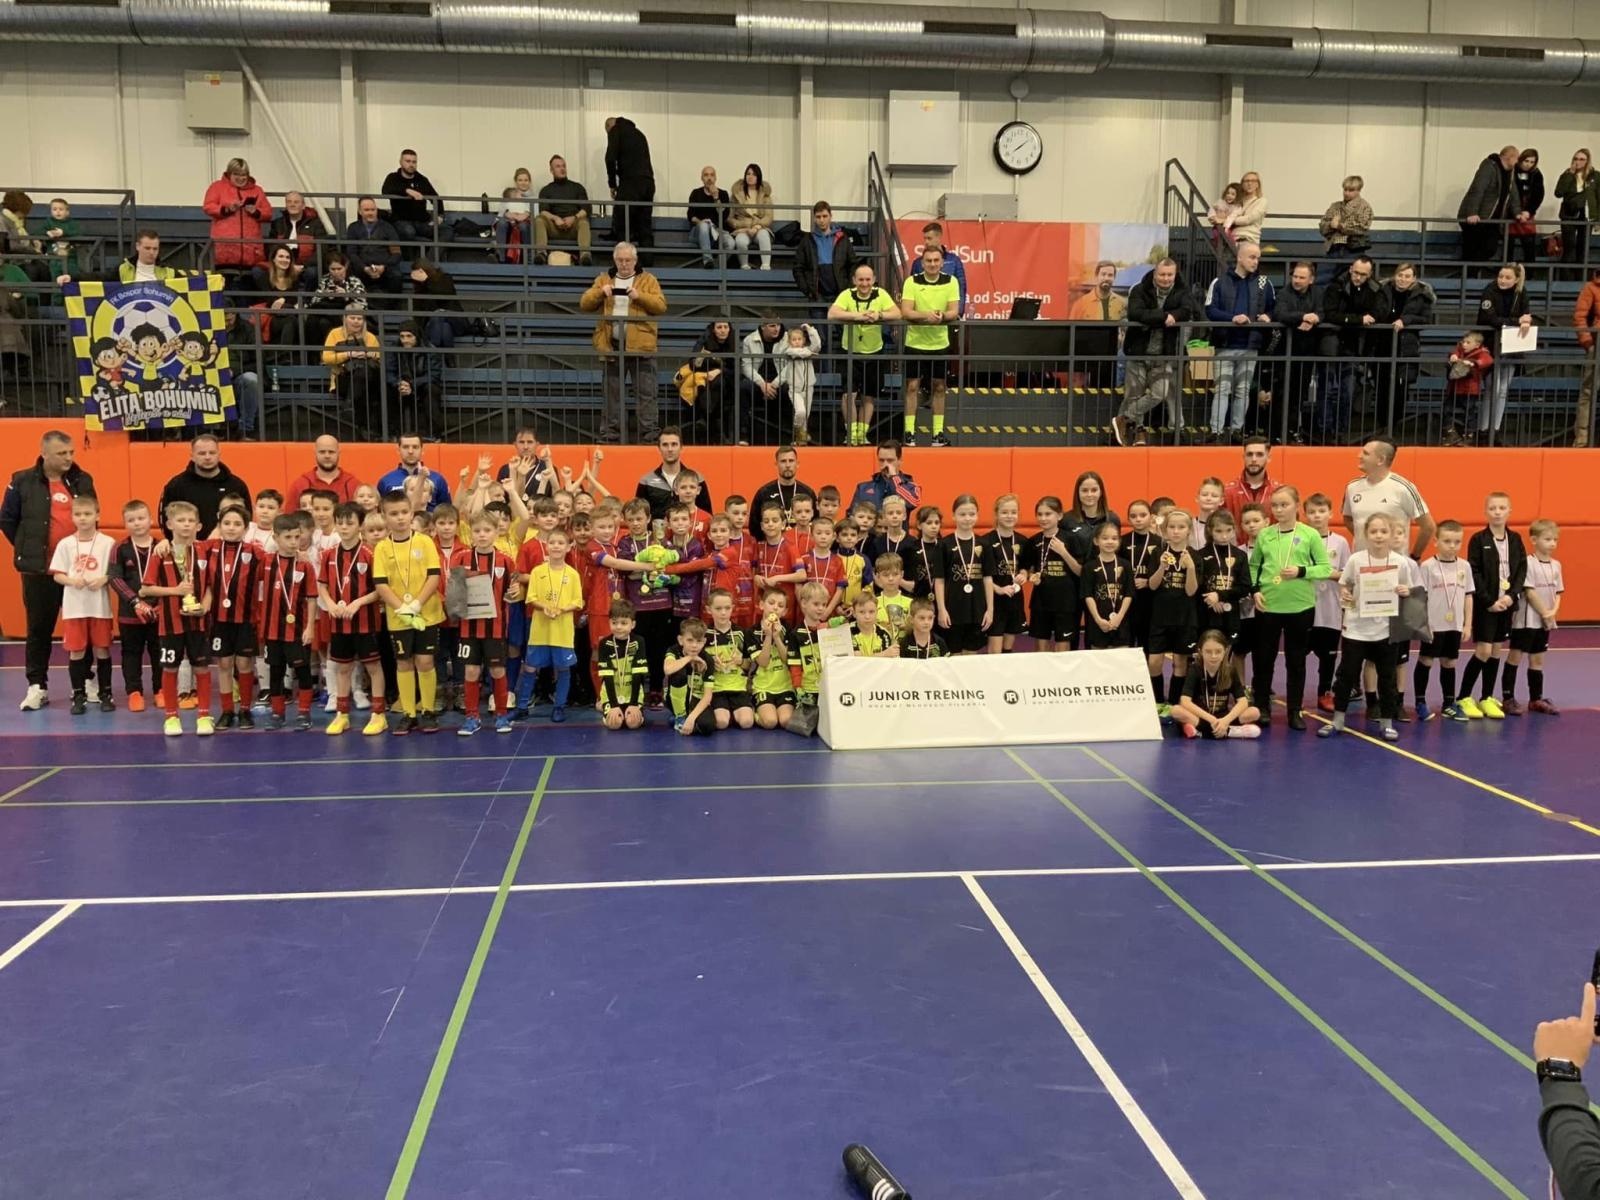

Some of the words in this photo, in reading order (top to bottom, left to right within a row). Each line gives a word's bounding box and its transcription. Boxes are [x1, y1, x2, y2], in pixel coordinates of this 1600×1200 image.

[914, 244, 994, 264] SSun
[974, 291, 990, 304] od
[100, 393, 140, 420] ELITA
[212, 637, 221, 651] 8
[396, 640, 405, 655] 1
[457, 643, 471, 658] 10
[160, 648, 176, 663] 13
[868, 690, 920, 701] JUNIOR
[924, 689, 985, 700] TRENING
[1031, 686, 1082, 698] JUNIOR
[1085, 684, 1145, 696] TRENING
